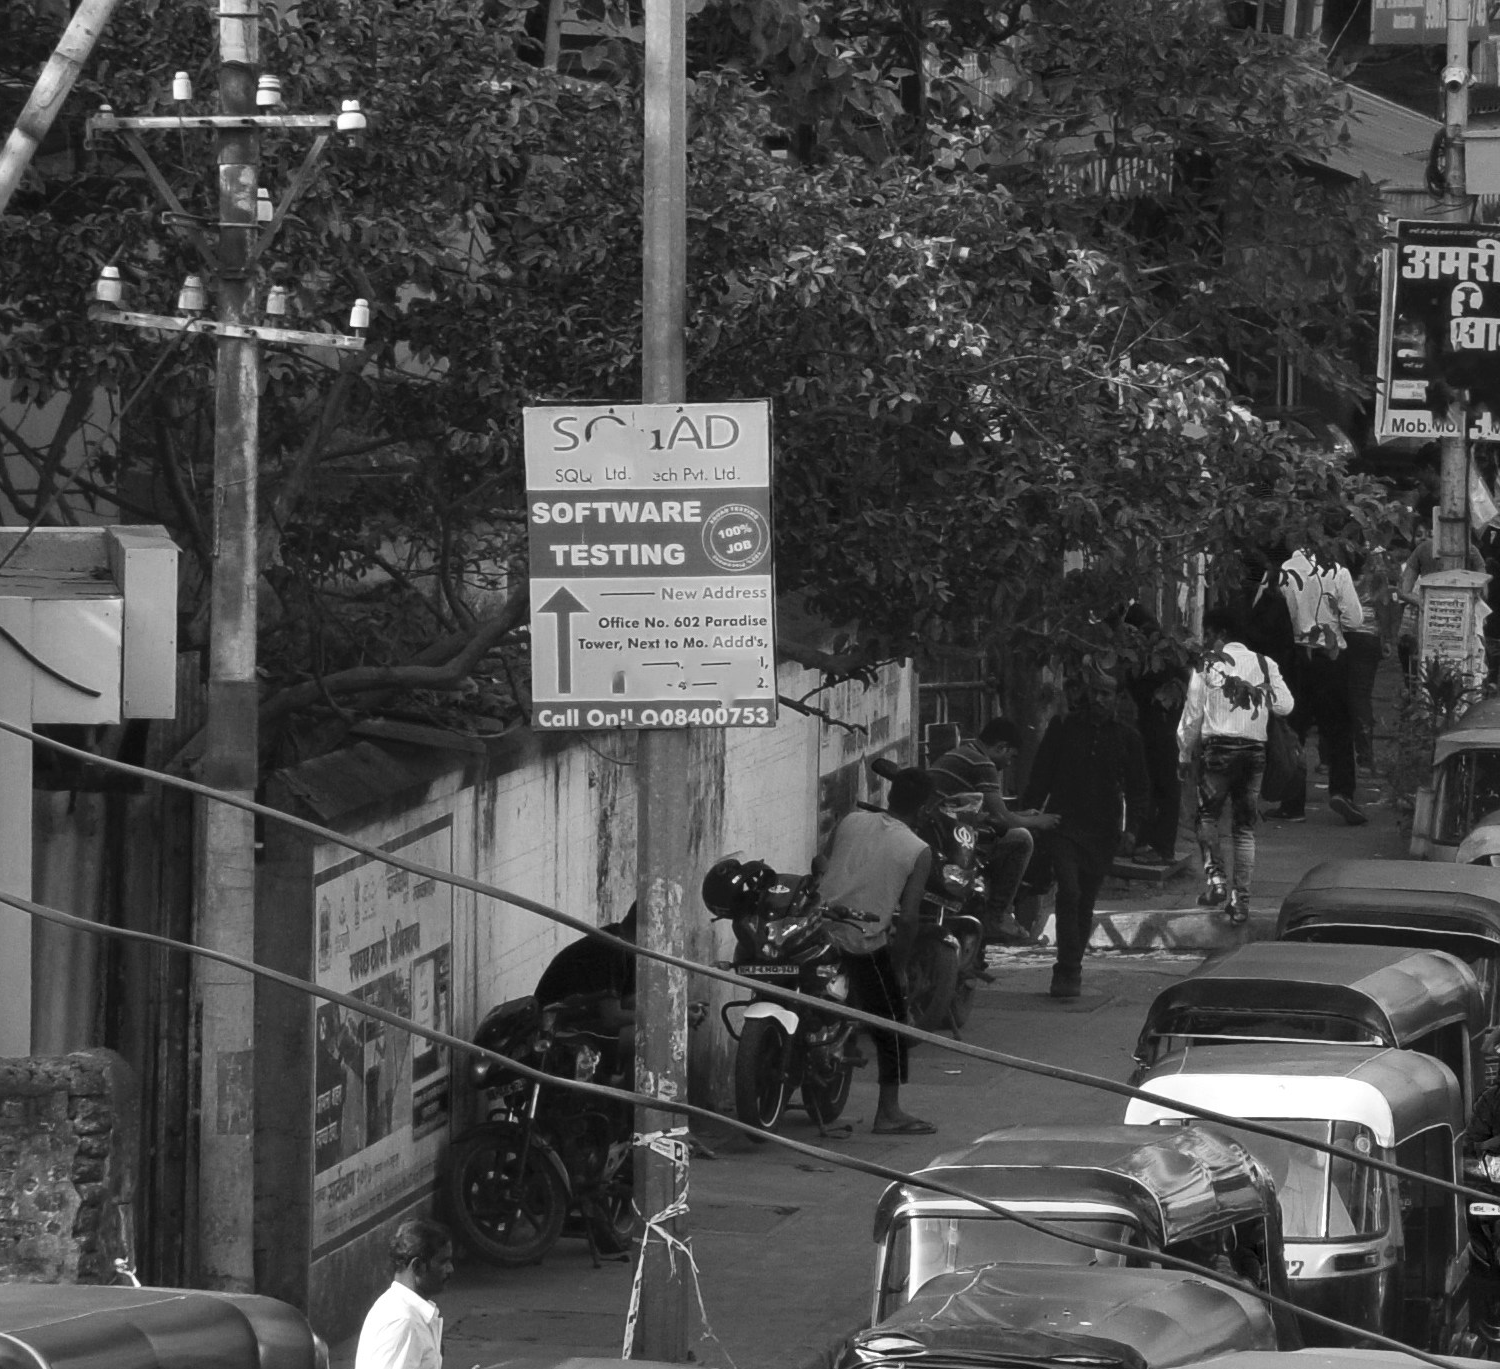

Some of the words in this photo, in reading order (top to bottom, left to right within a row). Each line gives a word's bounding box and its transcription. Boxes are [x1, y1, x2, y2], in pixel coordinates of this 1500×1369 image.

[605, 467, 631, 481] Ltd.
[683, 468, 709, 481] Pvt.
[714, 467, 741, 481] Ltd.
[532, 501, 702, 524] SOFTWARE
[719, 524, 753, 540] 100%
[550, 543, 686, 567] TESTING
[726, 540, 752, 555] JOB
[661, 588, 697, 601] New
[702, 586, 767, 600] Address
[598, 616, 640, 629] Office
[645, 616, 669, 628] No.
[674, 616, 700, 628] 602
[705, 615, 767, 627] Paradise
[578, 638, 622, 650] Tower,
[628, 638, 660, 650] Next
[665, 637, 678, 649] to
[683, 637, 708, 649] Mo.
[538, 709, 579, 727] Call
